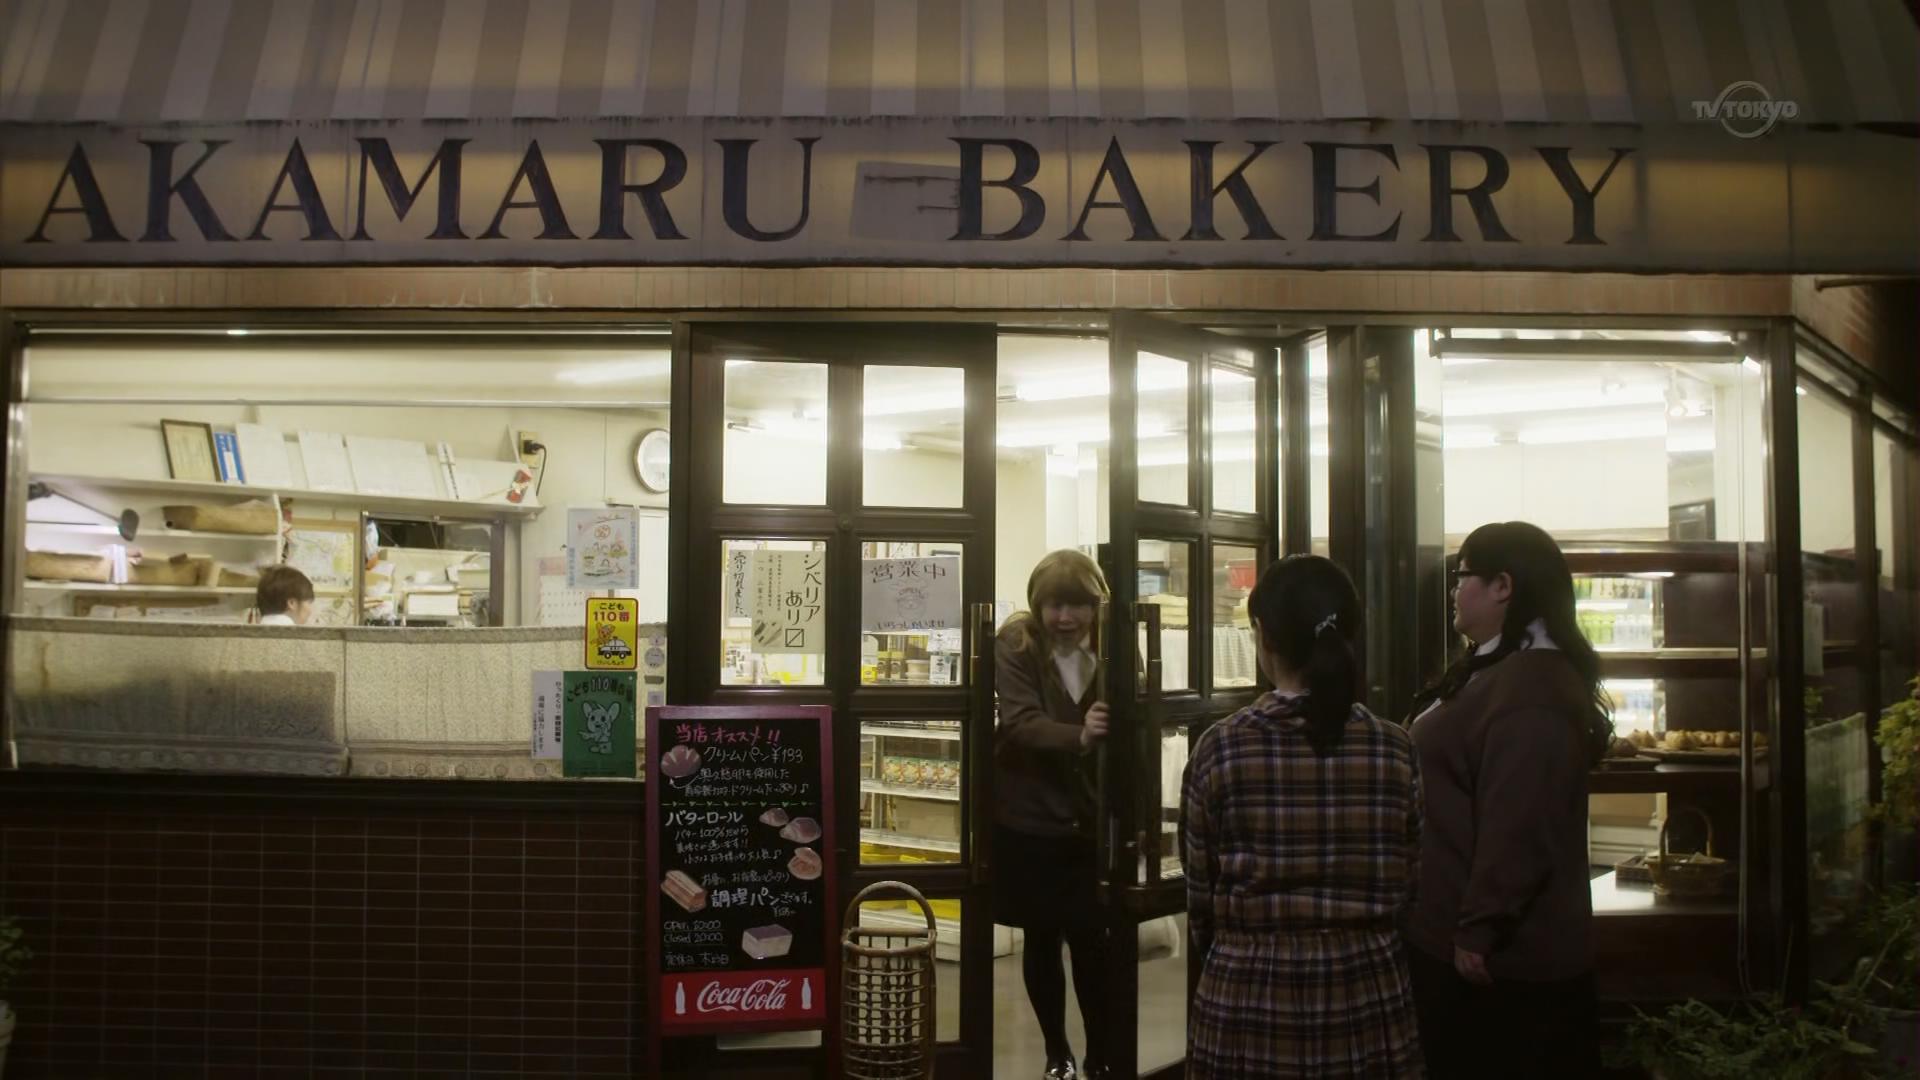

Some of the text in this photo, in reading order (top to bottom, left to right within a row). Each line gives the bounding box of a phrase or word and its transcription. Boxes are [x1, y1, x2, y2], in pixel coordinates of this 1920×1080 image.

[23, 135, 1638, 245] AKAMARU BAKERY
[870, 561, 946, 583] 営業中
[803, 553, 823, 622] シベリア
[599, 602, 625, 611] こども
[664, 810, 743, 827] バターロール
[696, 979, 792, 1012] Coca-Cola
